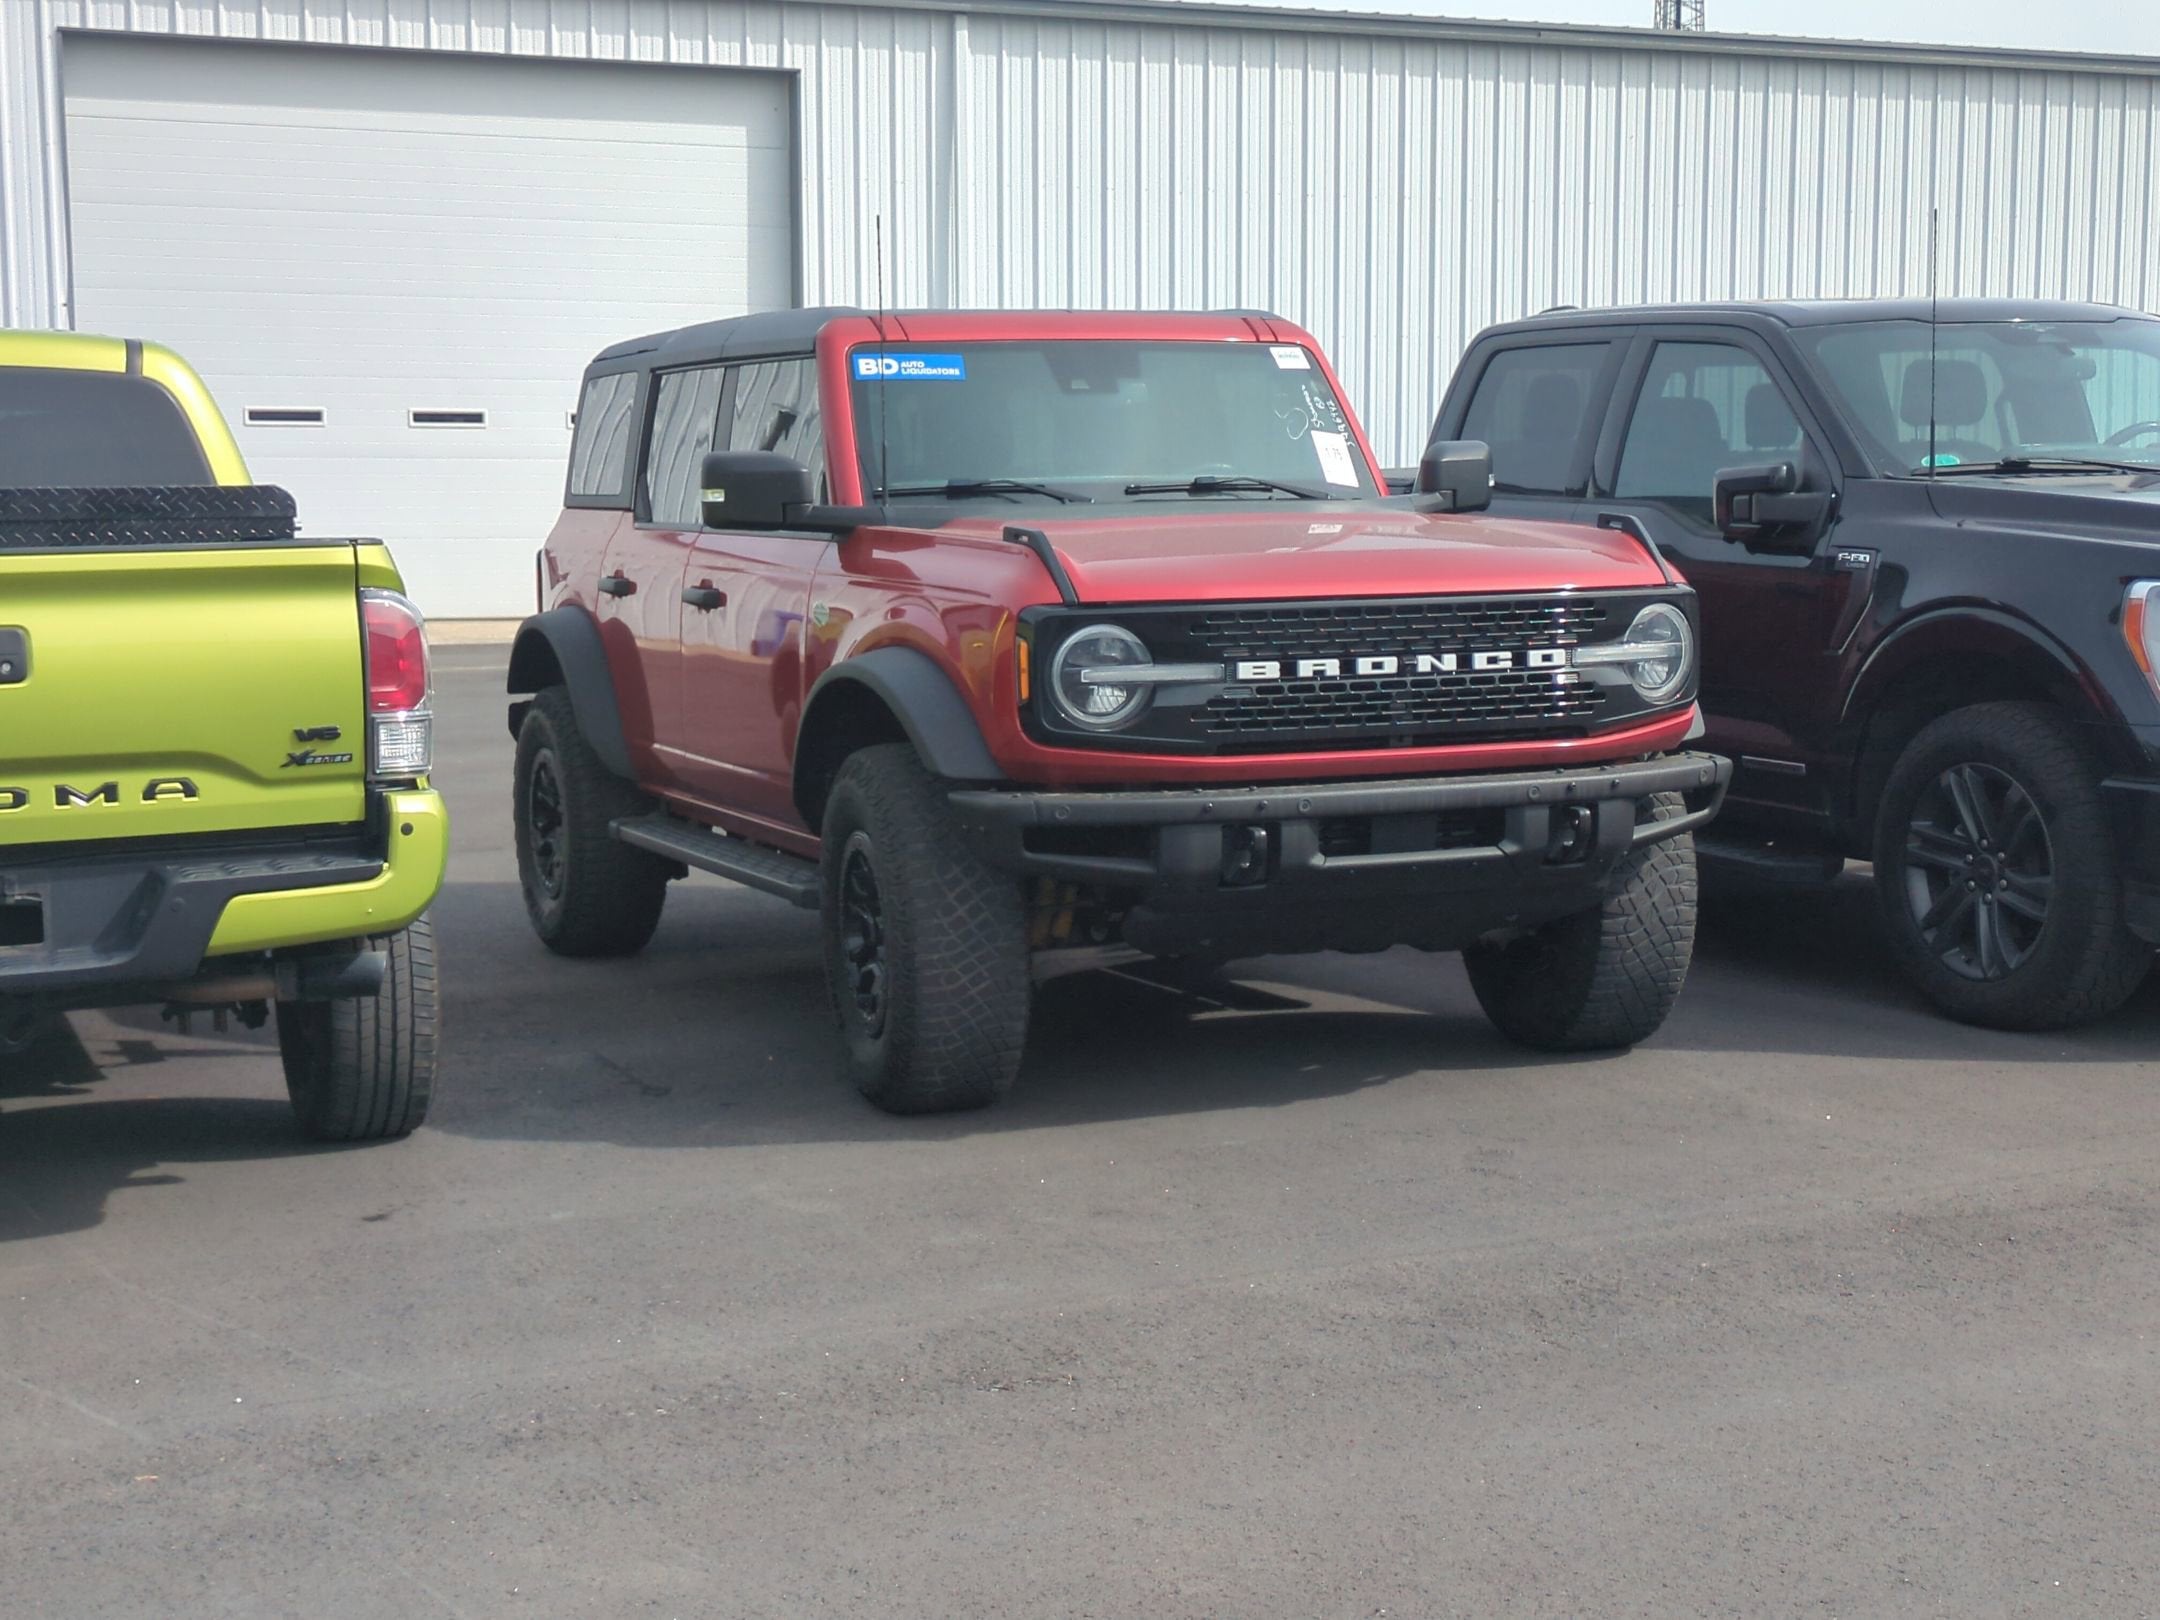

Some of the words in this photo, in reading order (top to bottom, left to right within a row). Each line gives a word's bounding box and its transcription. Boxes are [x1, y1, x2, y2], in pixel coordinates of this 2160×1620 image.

[858, 358, 899, 375] BD
[901, 368, 960, 376] LIQUIDATORS
[1236, 648, 1566, 680] BRONCO
[293, 726, 341, 742] V6
